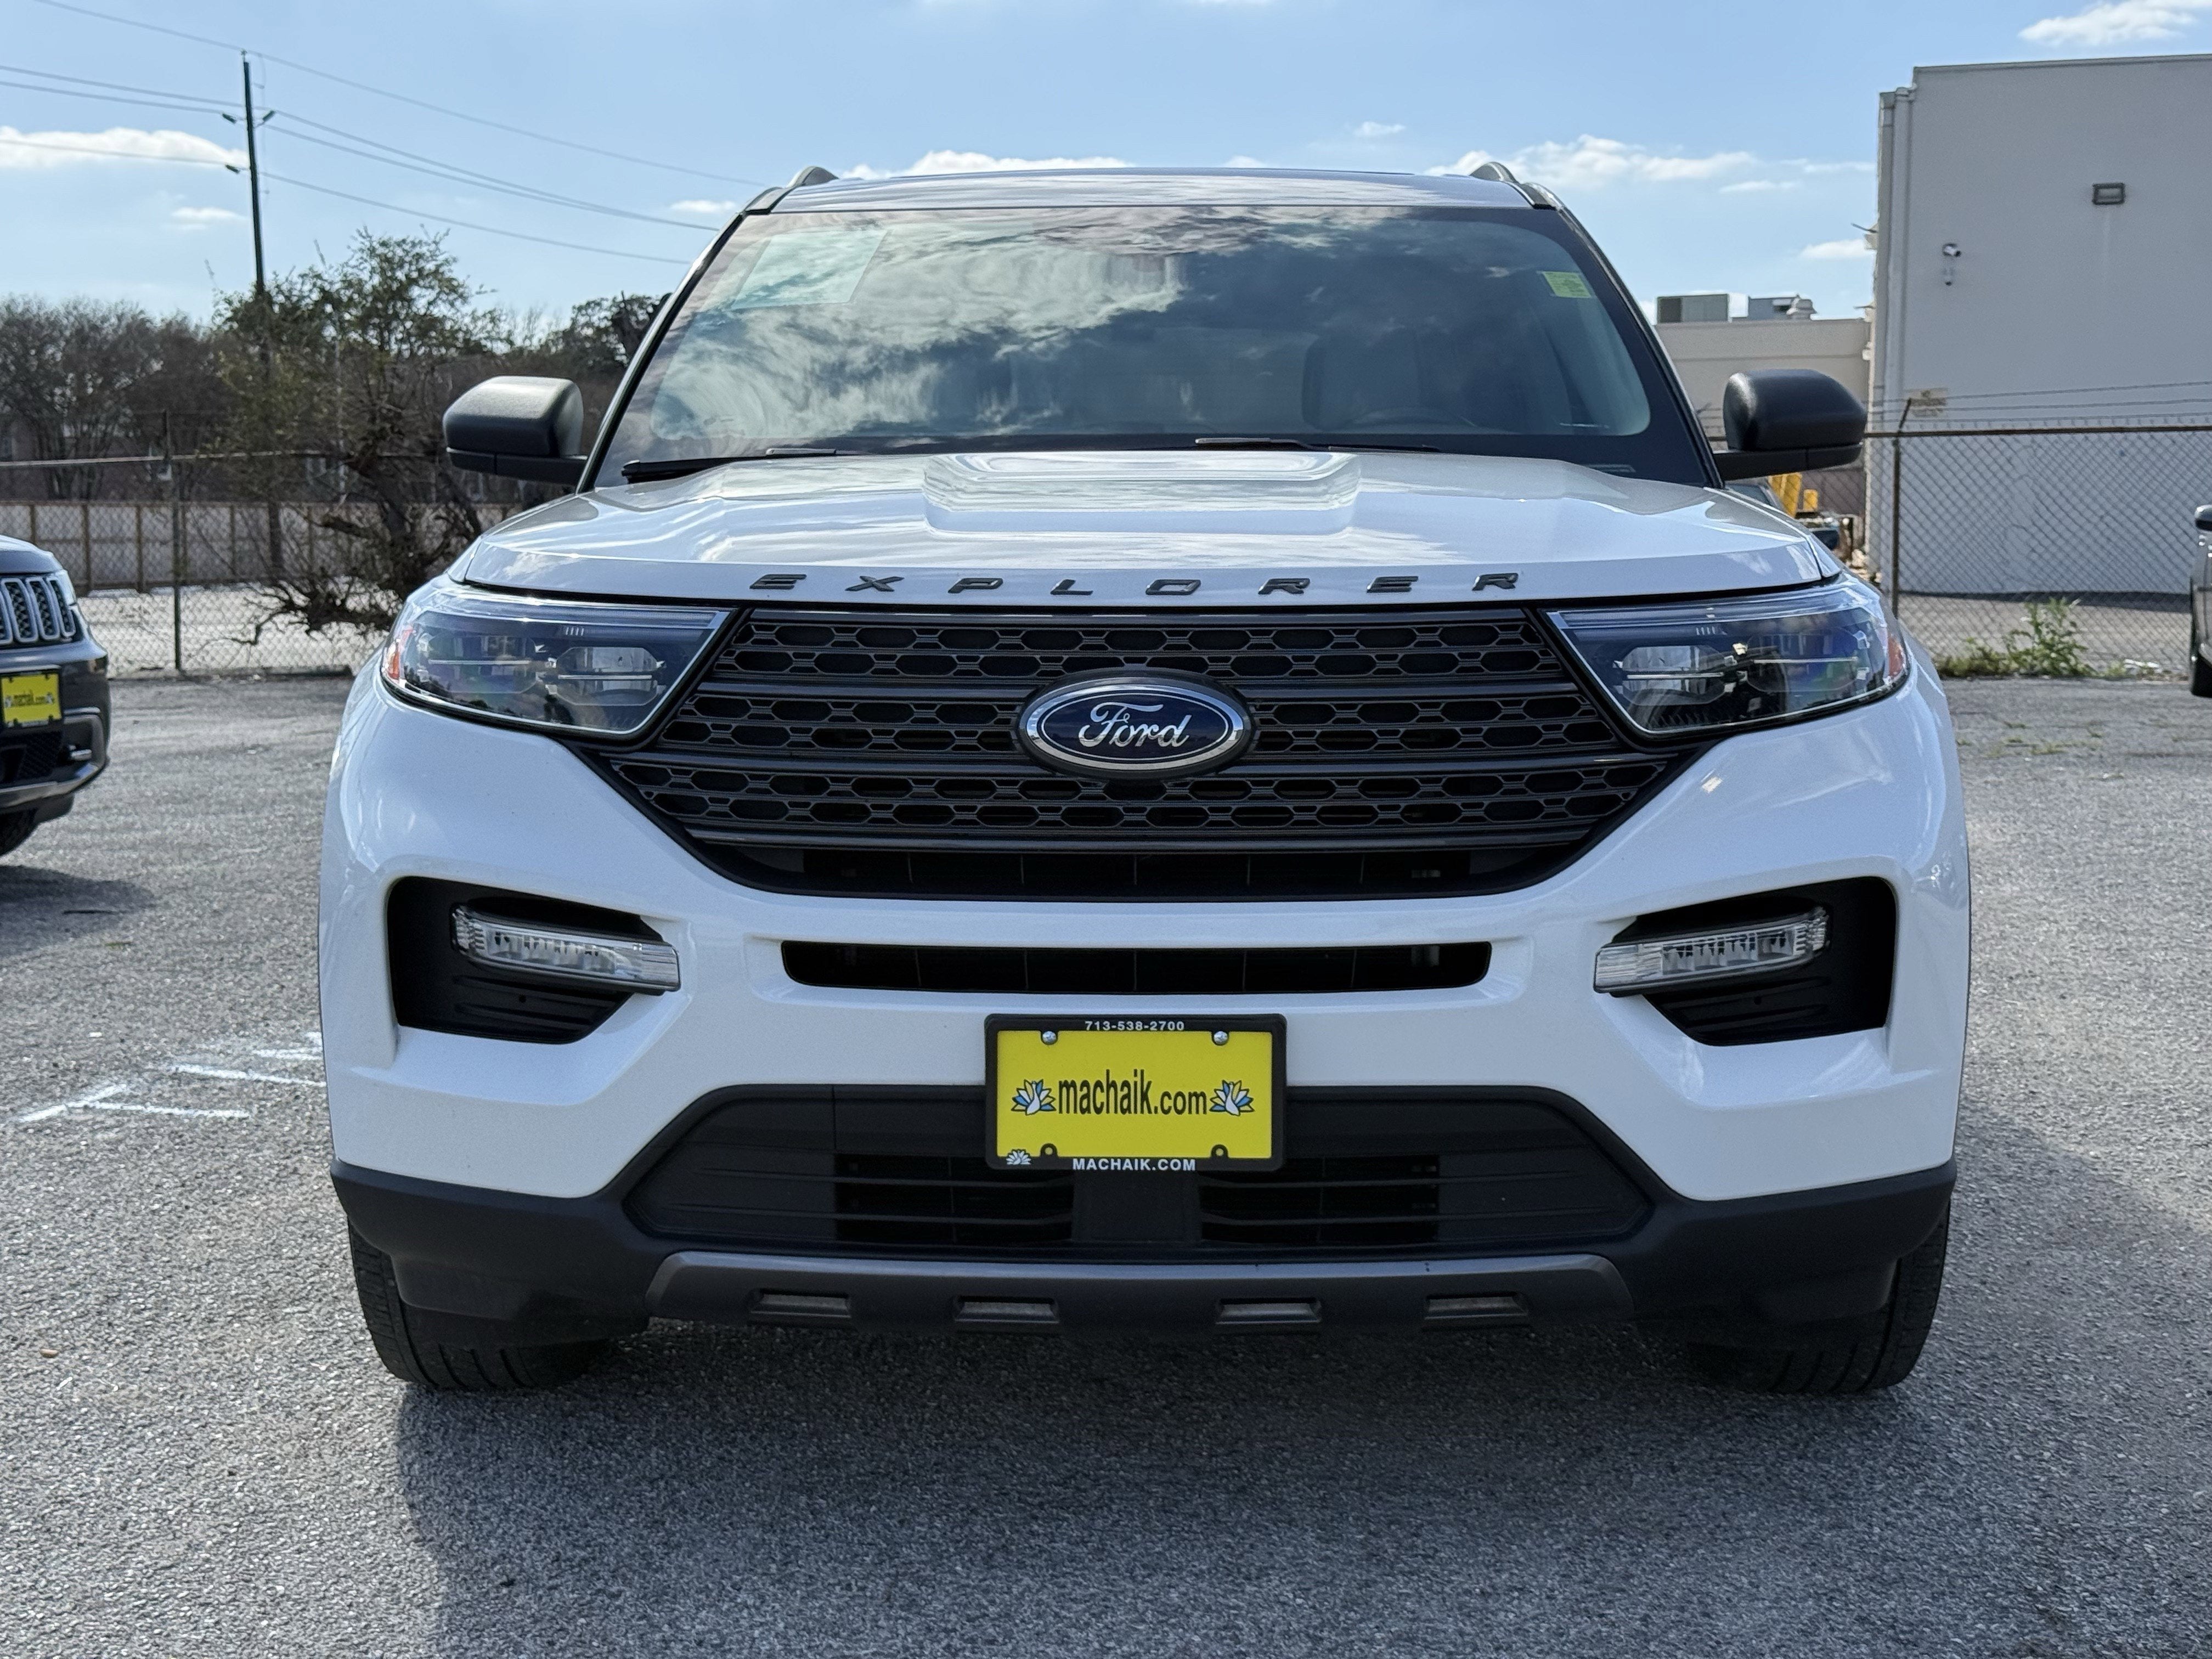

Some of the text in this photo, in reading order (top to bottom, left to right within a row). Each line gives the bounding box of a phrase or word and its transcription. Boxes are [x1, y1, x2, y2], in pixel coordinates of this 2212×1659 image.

[749, 572, 1519, 596] EXPLORER
[1078, 702, 1192, 747] Ford
[1085, 1020, 1184, 1031] 713-538-2700
[1058, 1069, 1207, 1115] machaik.com
[1073, 1159, 1196, 1171] MACHAIK.COM
